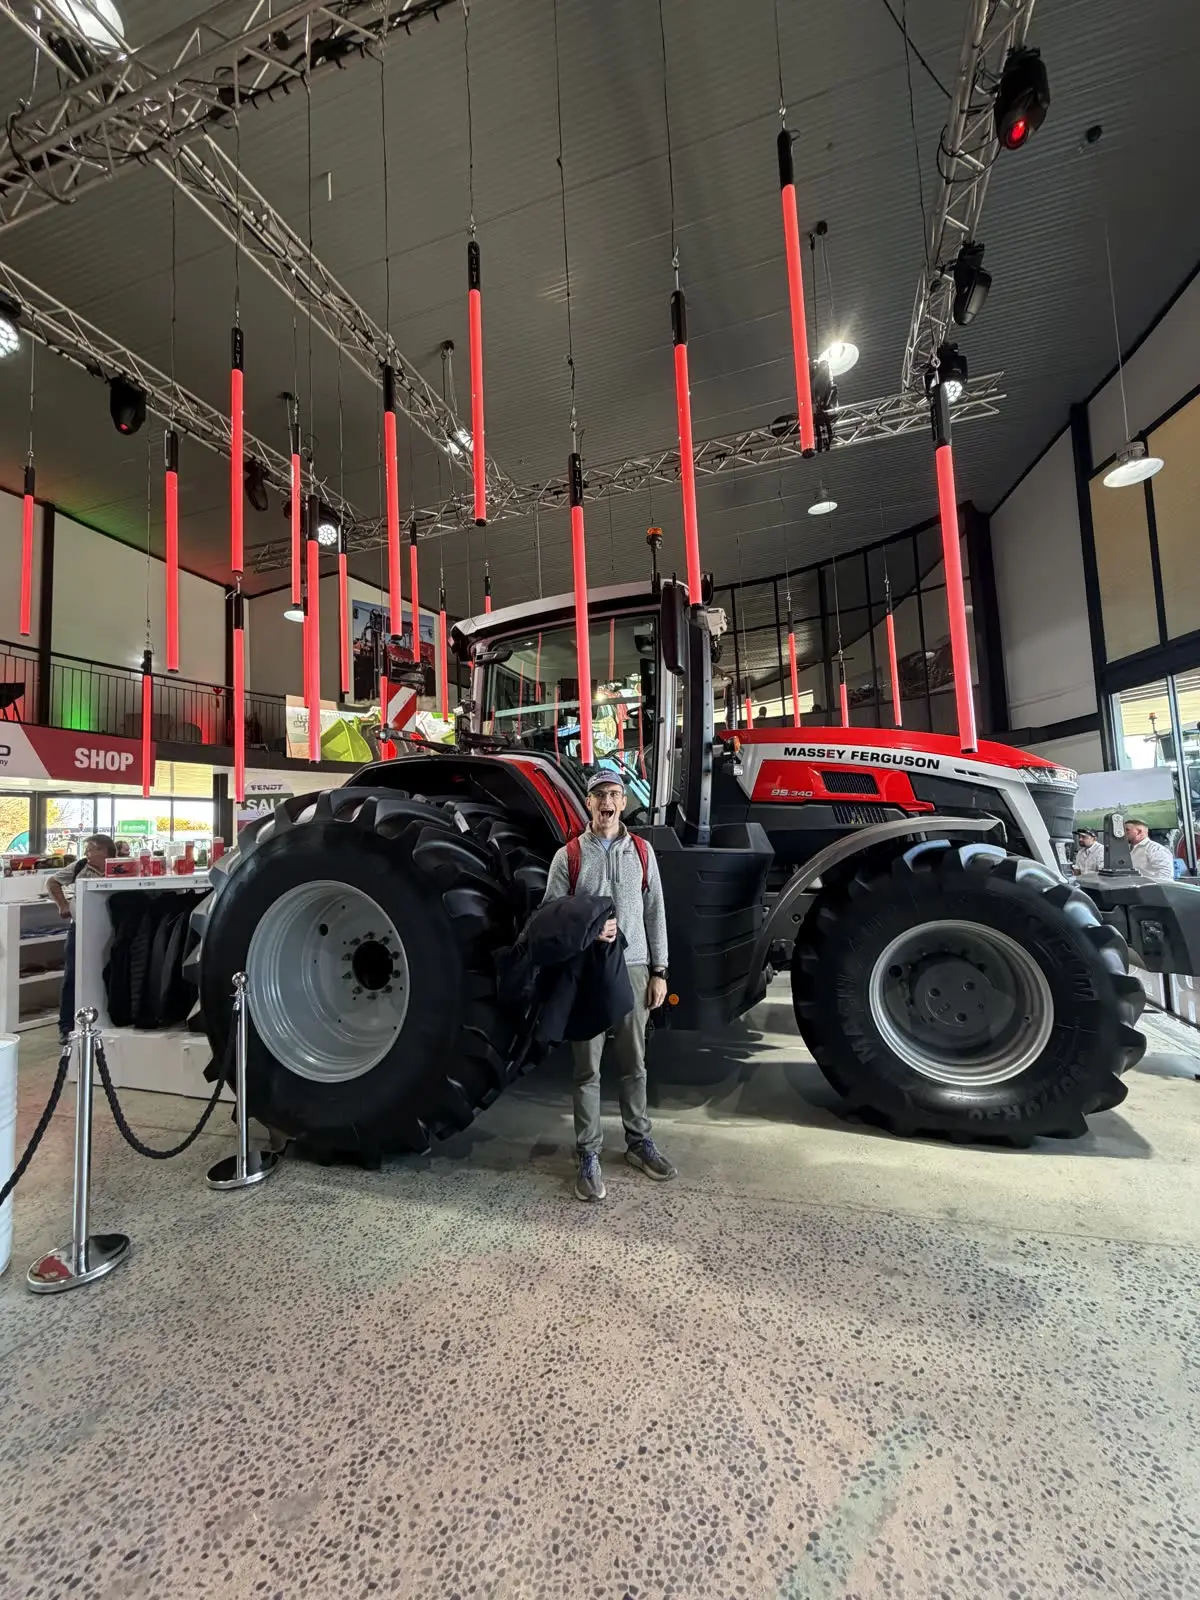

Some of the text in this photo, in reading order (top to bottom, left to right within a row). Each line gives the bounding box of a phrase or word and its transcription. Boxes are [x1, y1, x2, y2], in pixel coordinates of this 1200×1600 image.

[74, 747, 134, 771] SHOP
[783, 746, 941, 770] MASSEY FERGUSON
[771, 788, 814, 797] 9S.340
[246, 798, 289, 811] SAL
